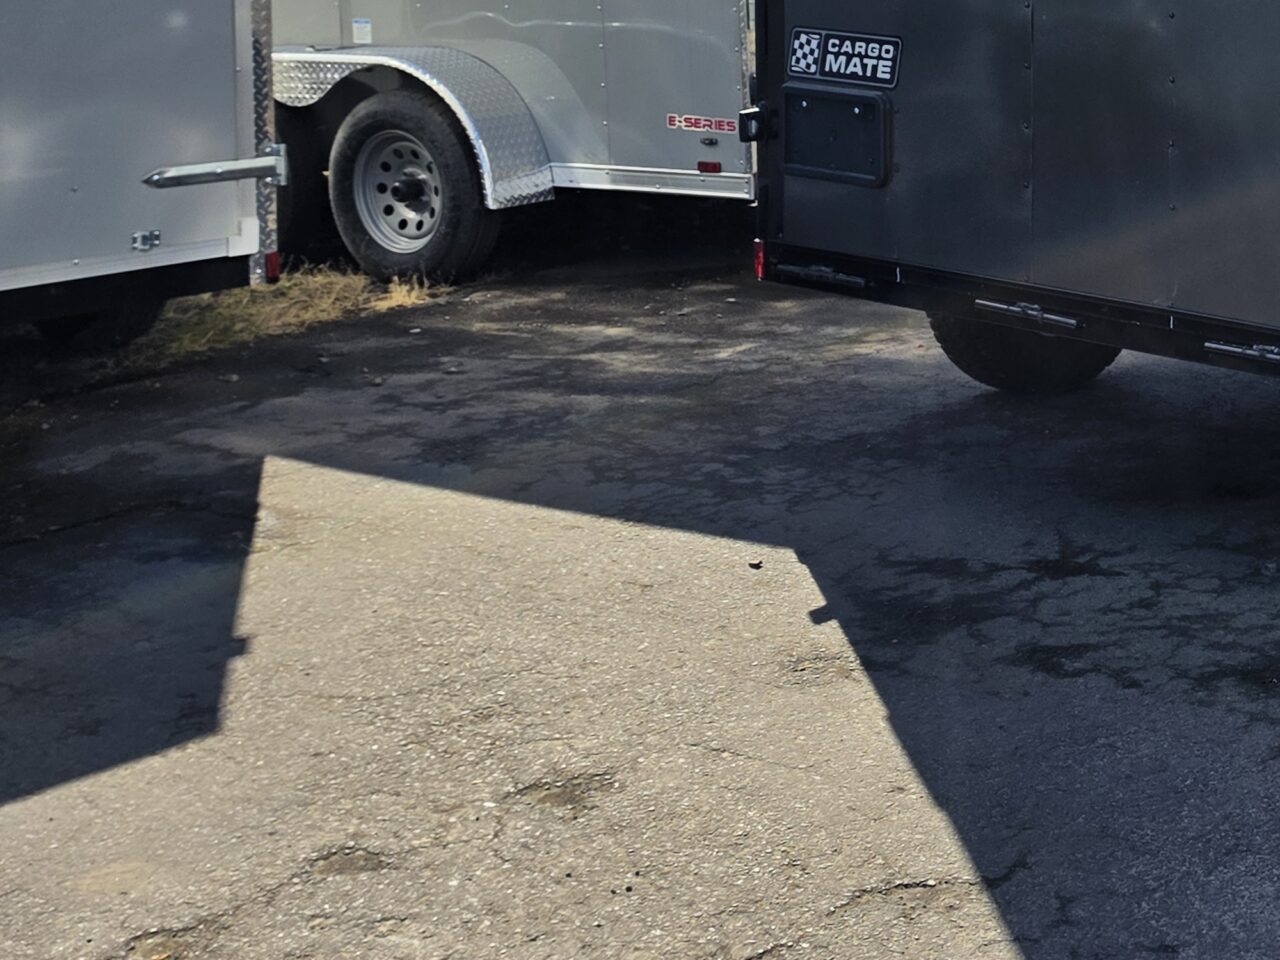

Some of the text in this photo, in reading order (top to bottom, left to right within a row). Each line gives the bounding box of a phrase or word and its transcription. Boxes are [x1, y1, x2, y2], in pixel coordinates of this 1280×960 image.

[827, 39, 894, 59] CARGO
[824, 54, 893, 79] MATE
[667, 113, 737, 134] E-SERIES
